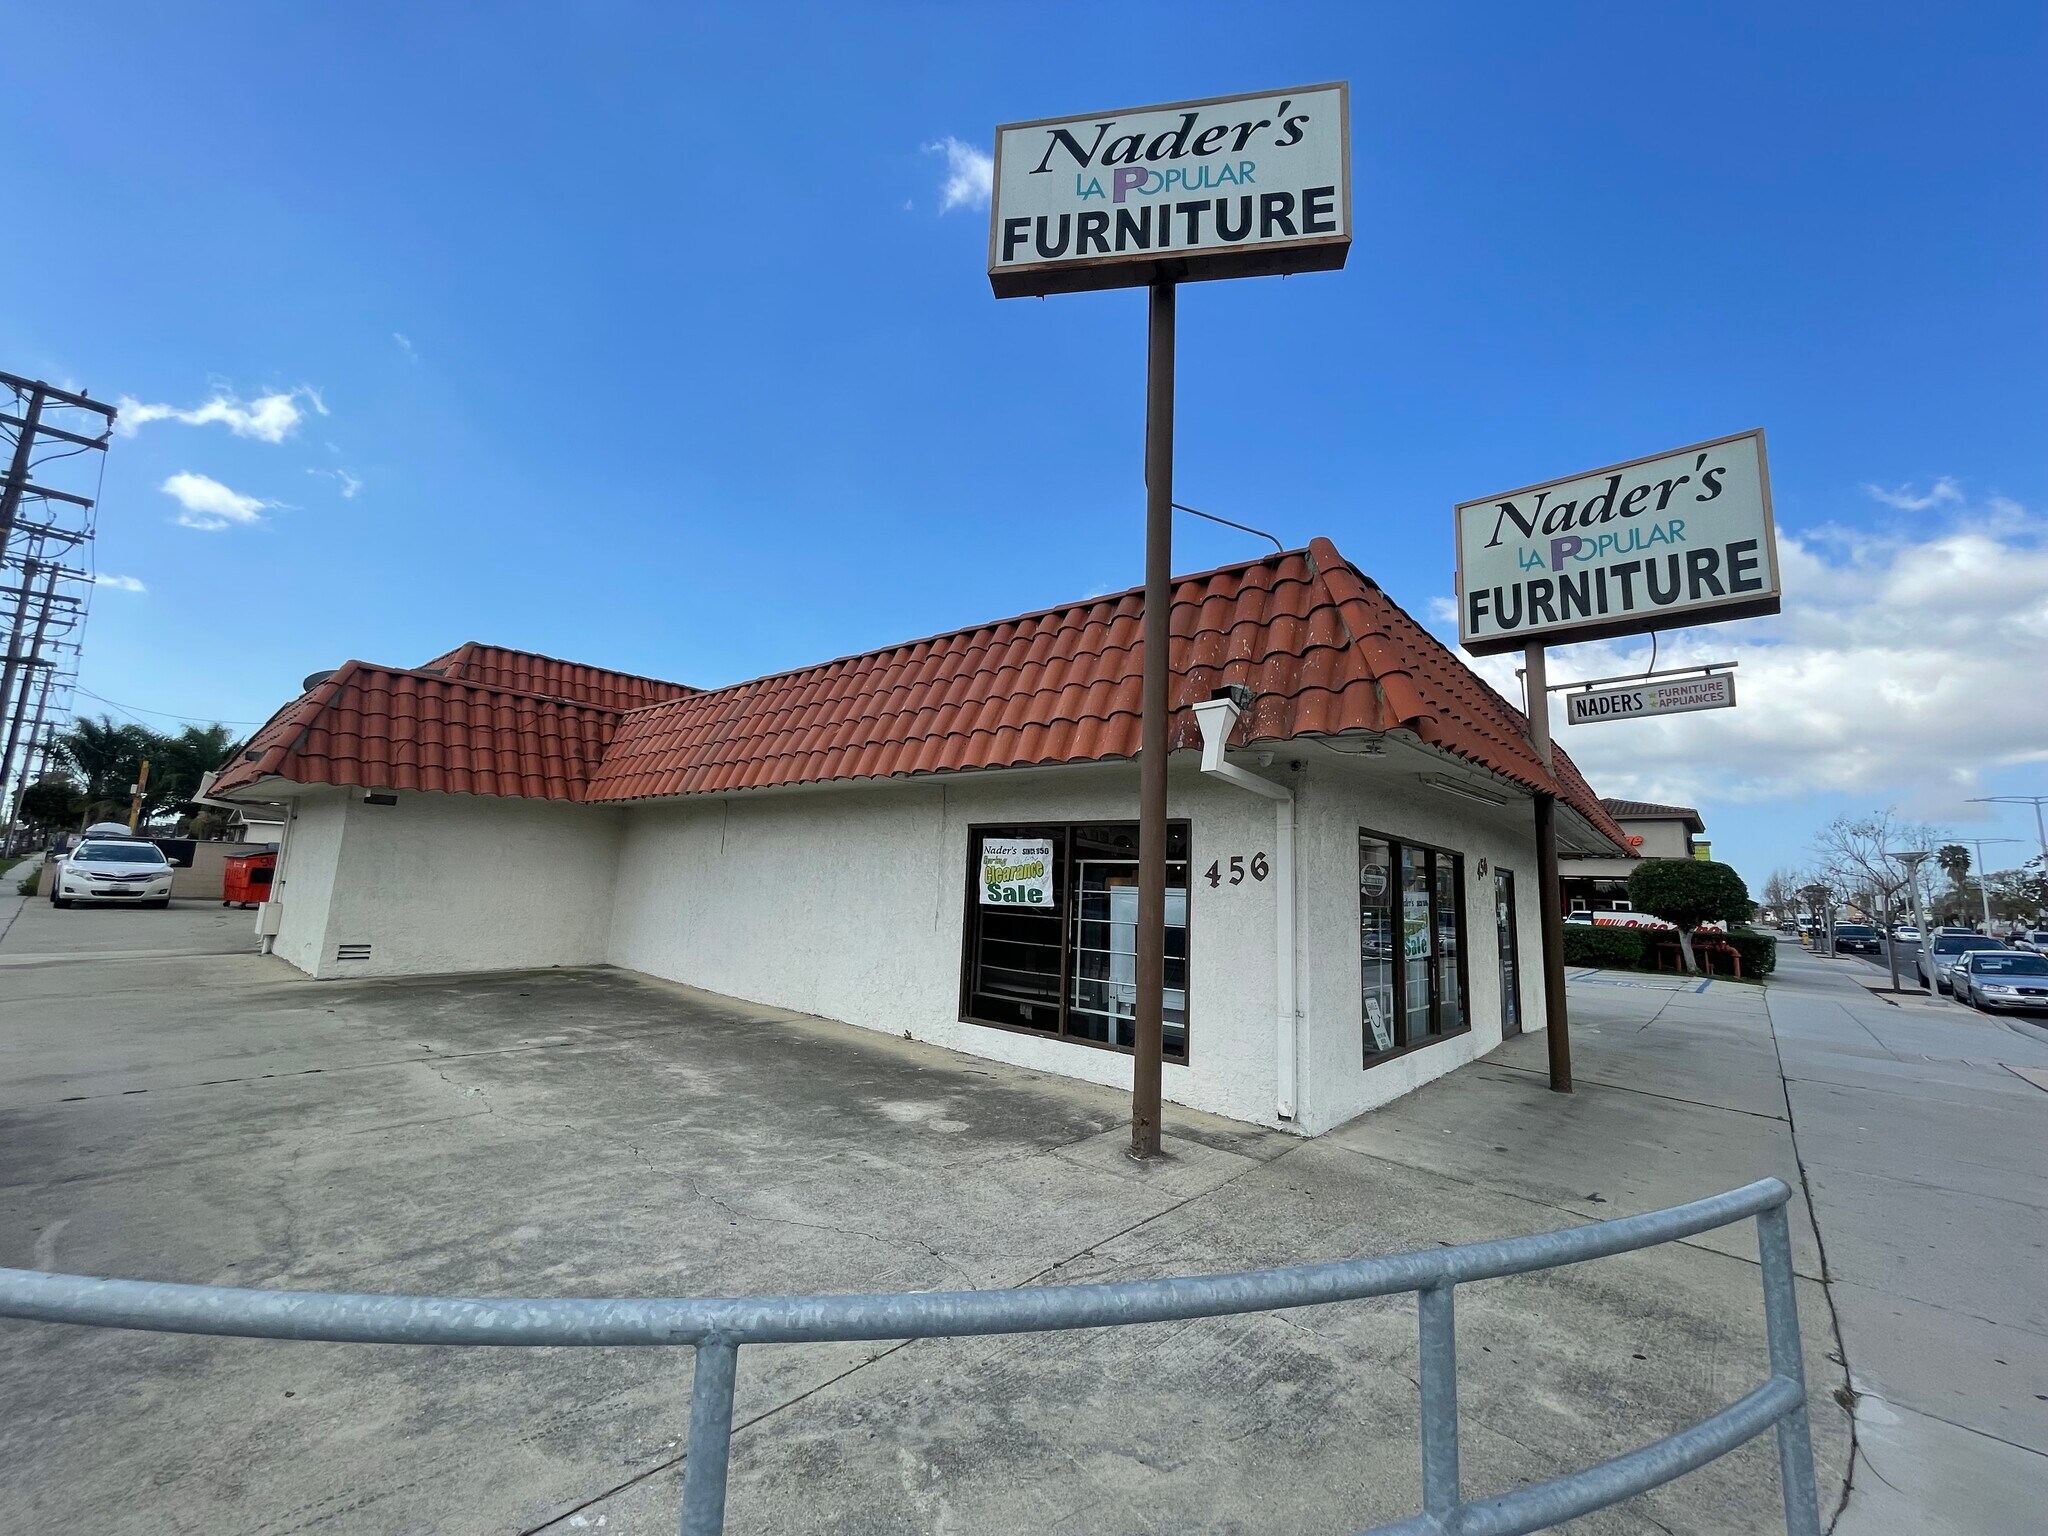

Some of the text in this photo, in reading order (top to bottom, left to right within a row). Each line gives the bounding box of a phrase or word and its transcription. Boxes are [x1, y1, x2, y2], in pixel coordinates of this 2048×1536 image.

[1029, 100, 1310, 174] Nader's
[1077, 160, 1256, 203] LA POPULAR
[1002, 185, 1336, 262] FURNITURE
[1484, 453, 1726, 548] Nader's
[1518, 519, 1686, 572] LA POPULAR
[1469, 538, 1763, 634] FURNITURE
[1575, 692, 1643, 718] NADERS
[1658, 681, 1723, 698] FURNITURE
[1658, 692, 1725, 708] APPLIANCES
[983, 845, 1018, 855] Nader's
[984, 860, 1044, 885] Clearance
[1204, 851, 1269, 889] 456
[987, 883, 1043, 904] Sale
